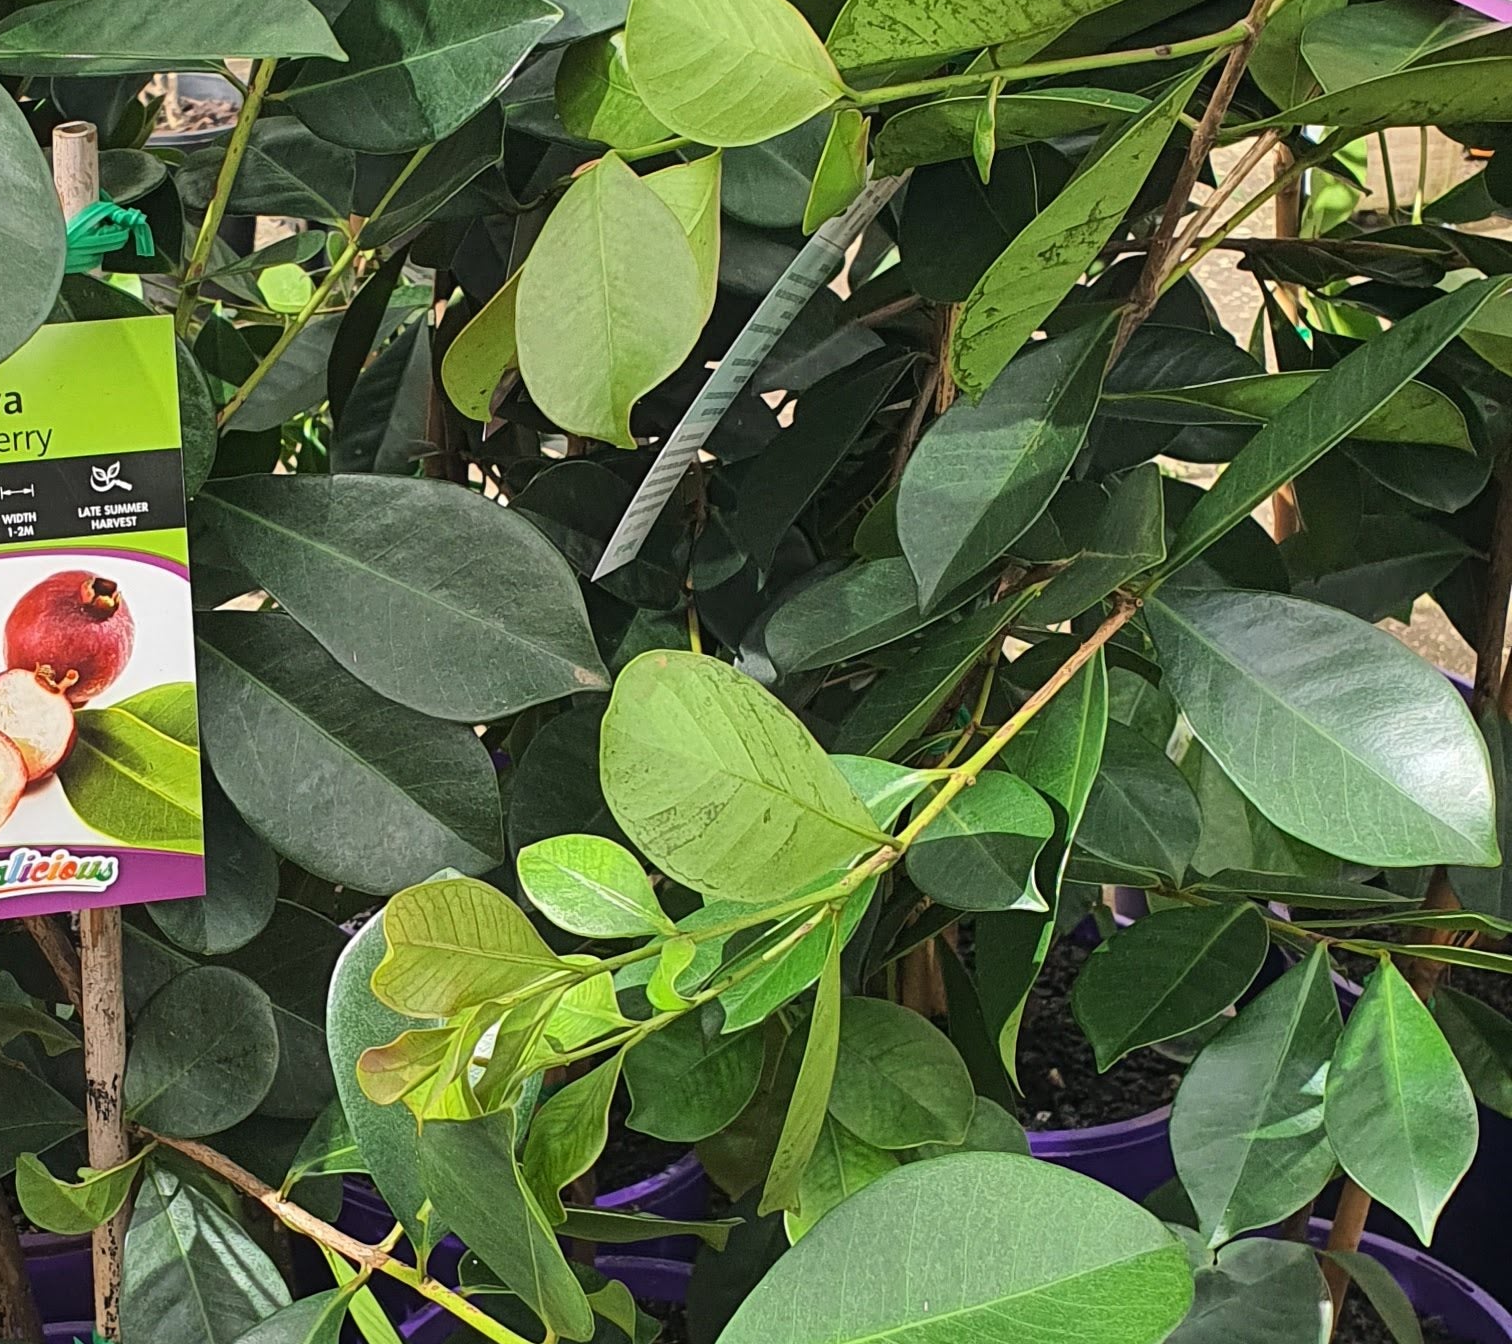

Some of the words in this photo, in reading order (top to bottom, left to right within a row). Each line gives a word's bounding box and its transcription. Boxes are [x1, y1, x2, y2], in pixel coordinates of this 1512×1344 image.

[77, 506, 102, 519] LATE
[104, 502, 150, 516] SUMMER
[1, 511, 38, 526] WIDTH
[90, 516, 138, 531] HARVEST
[7, 524, 35, 538] 1-2M
